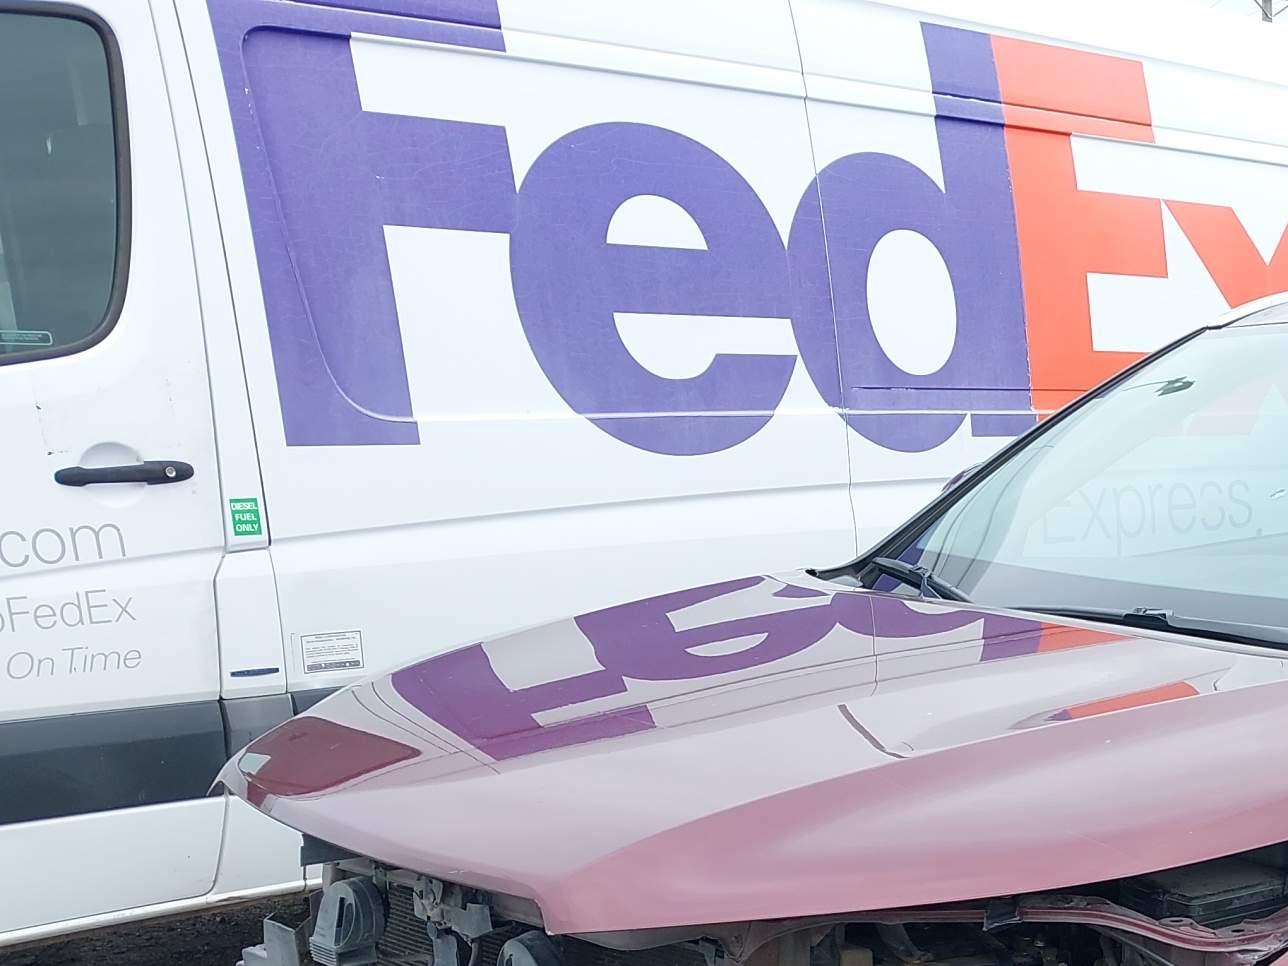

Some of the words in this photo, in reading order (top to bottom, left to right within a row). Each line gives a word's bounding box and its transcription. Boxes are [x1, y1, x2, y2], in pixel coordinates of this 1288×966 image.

[230, 502, 258, 511] DIESEL
[235, 512, 257, 521] FUEL
[236, 523, 259, 532] ONLY
[1043, 479, 1252, 556] Express
[0, 589, 136, 633] FedEx
[6, 651, 55, 680] On
[61, 646, 142, 674] Time
